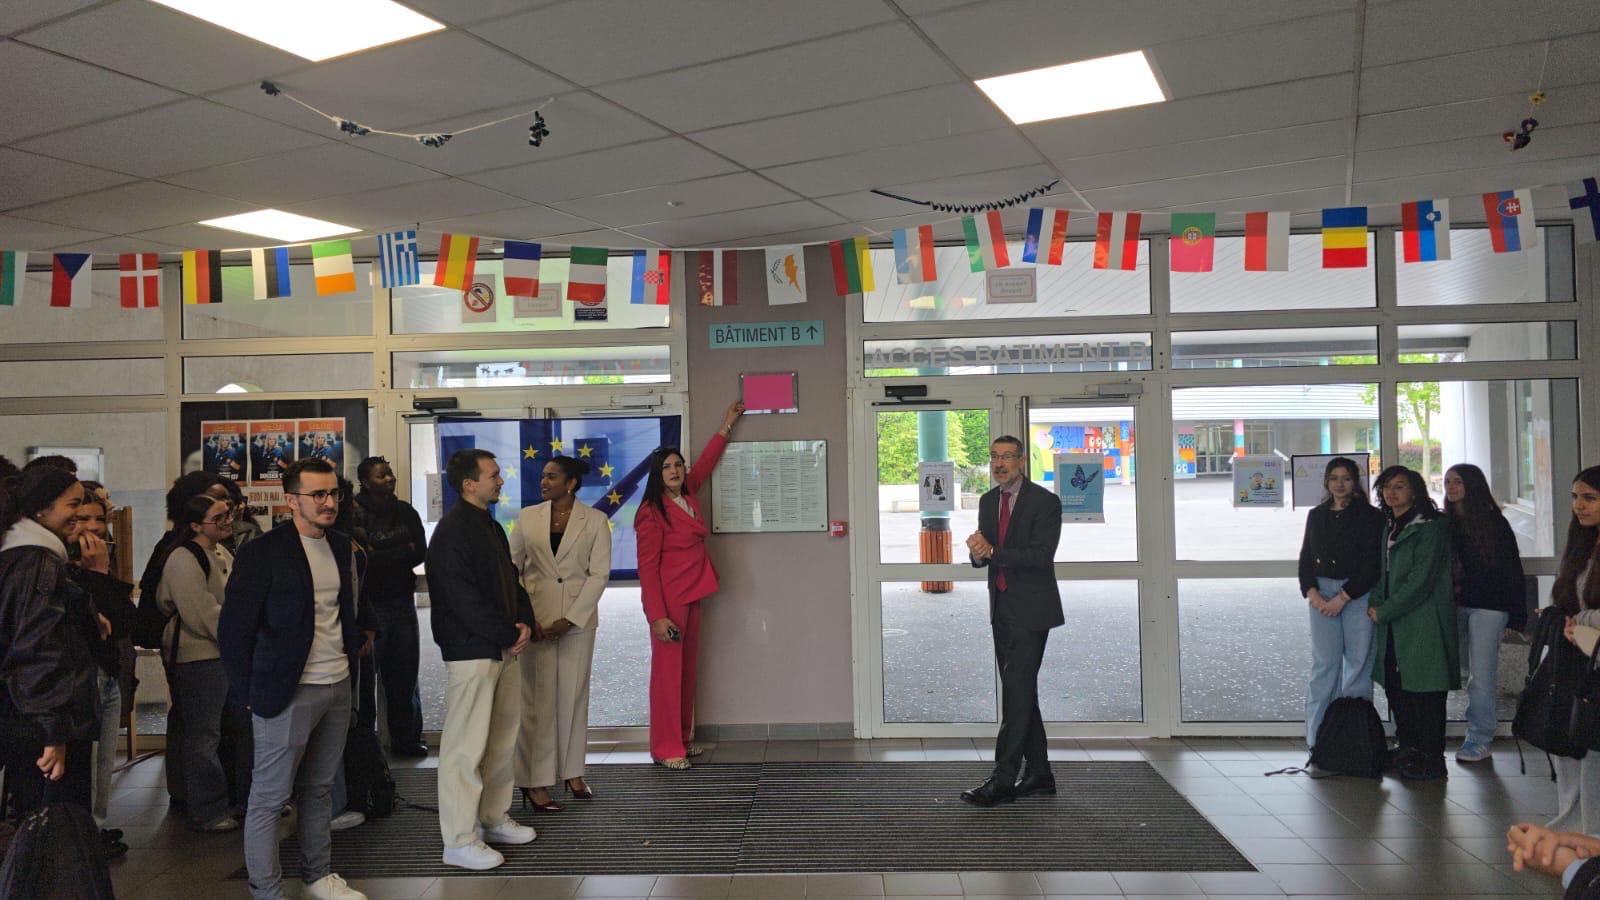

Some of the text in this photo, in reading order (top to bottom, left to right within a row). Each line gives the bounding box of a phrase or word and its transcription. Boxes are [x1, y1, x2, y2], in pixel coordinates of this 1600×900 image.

[715, 325, 801, 343] BÂTIMENT B
[871, 341, 1147, 368] ACCES BATIMENT B
